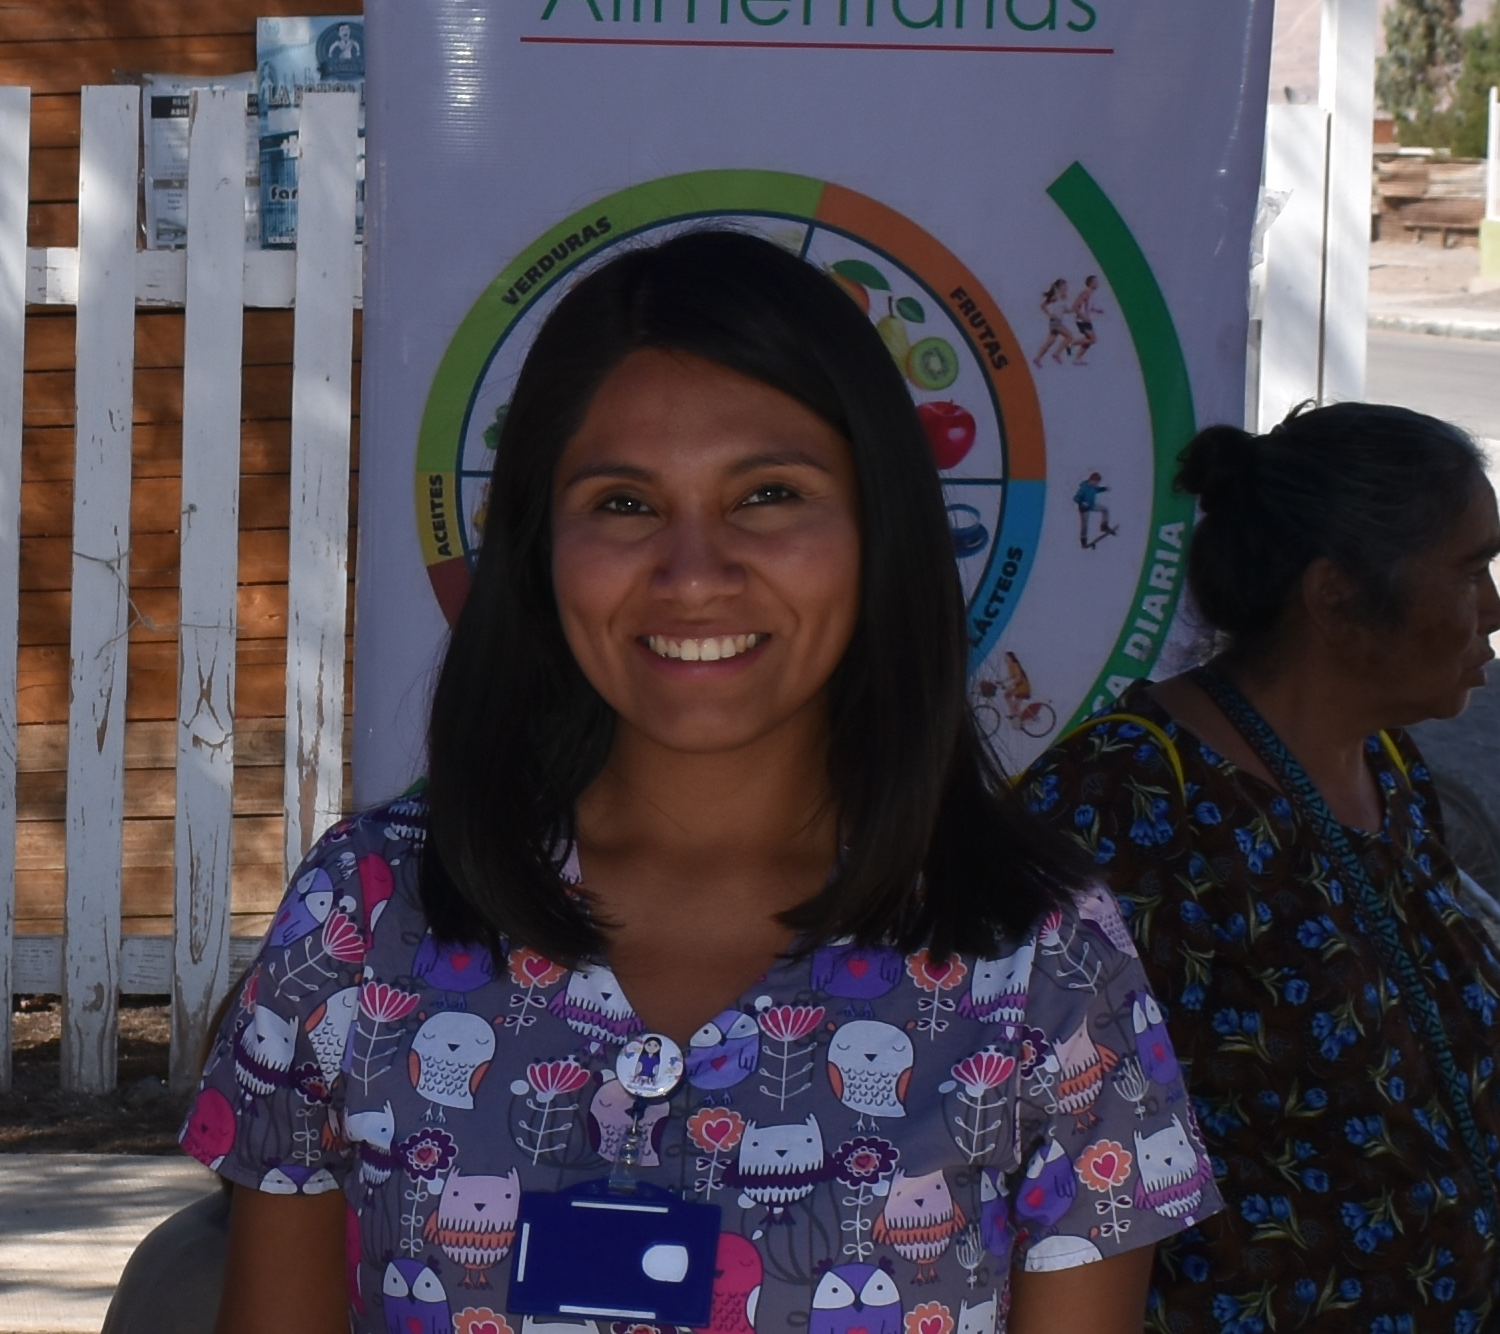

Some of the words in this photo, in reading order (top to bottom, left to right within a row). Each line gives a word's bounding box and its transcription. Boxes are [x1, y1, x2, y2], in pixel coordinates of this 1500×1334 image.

[501, 214, 612, 308] VERDURAS
[948, 286, 1011, 373] FRUTAS
[426, 471, 454, 558] ACEITES
